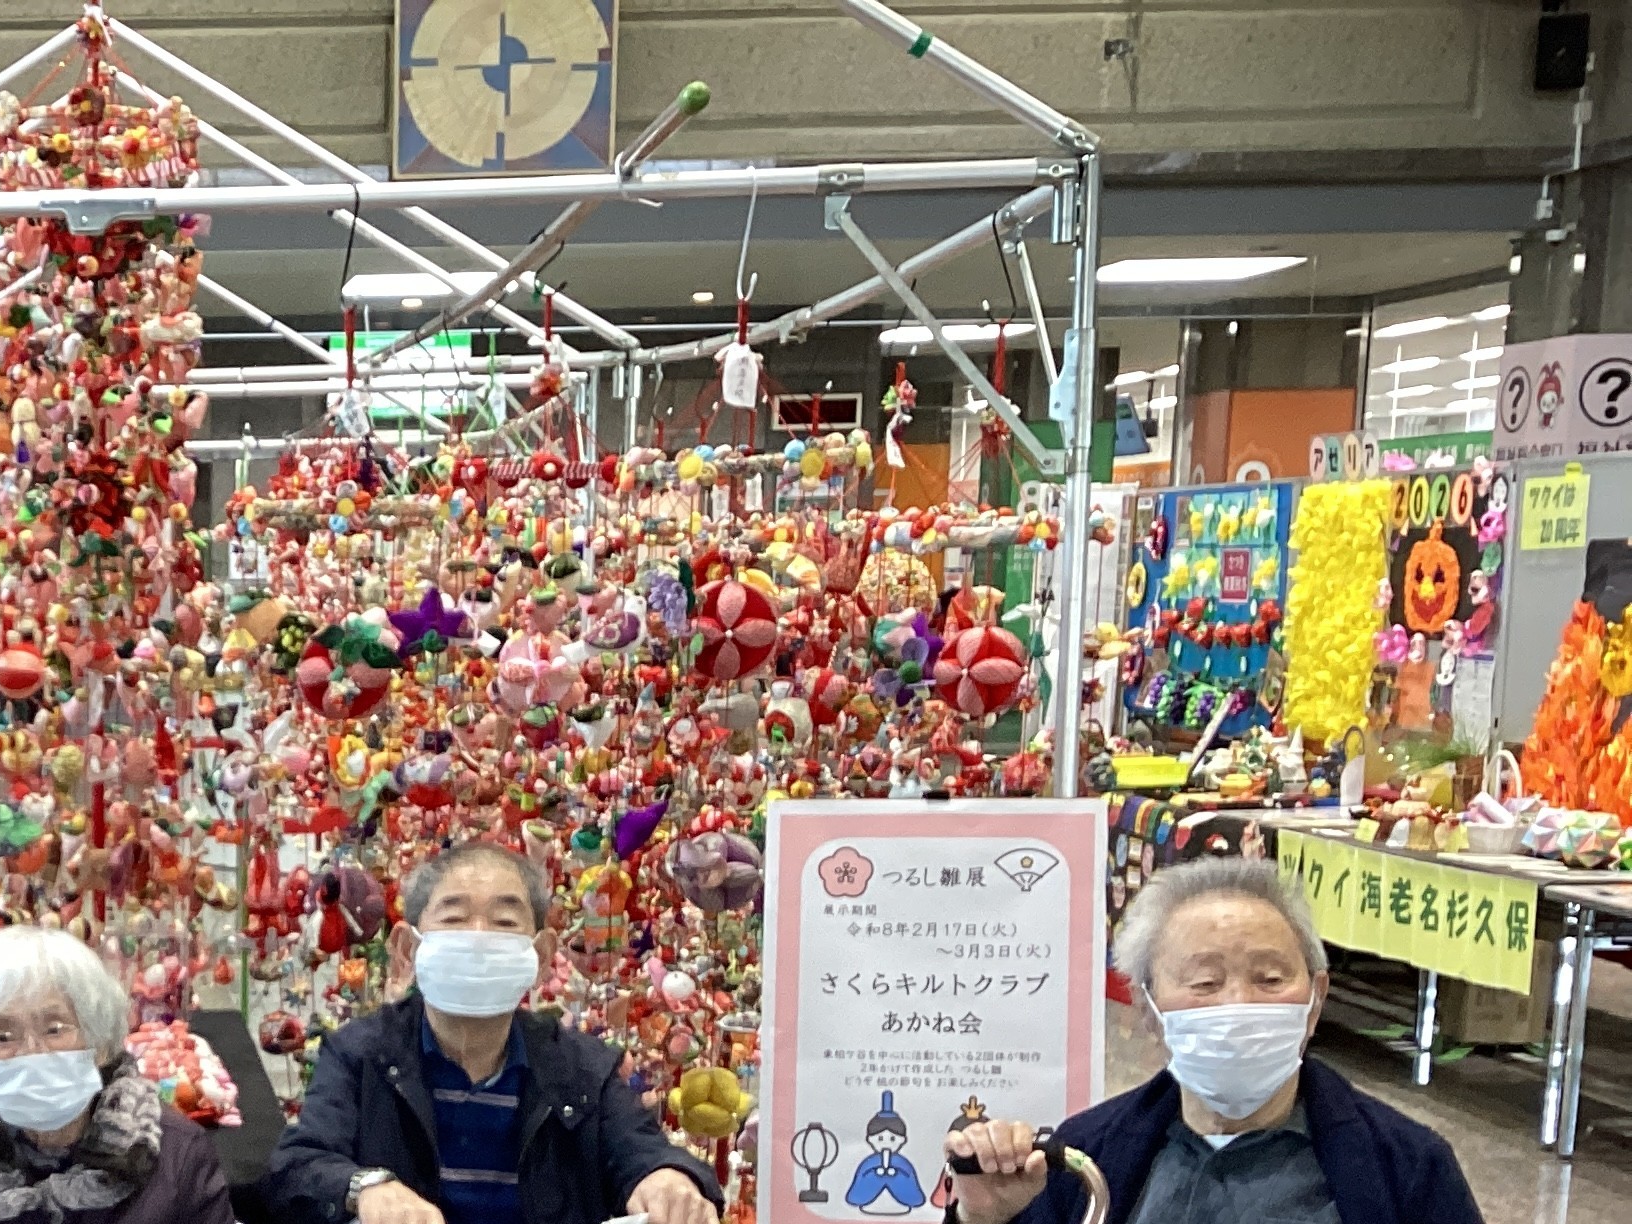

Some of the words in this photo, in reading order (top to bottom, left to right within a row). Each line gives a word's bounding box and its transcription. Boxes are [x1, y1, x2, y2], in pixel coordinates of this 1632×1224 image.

[1394, 481, 1474, 518] 2026
[882, 866, 987, 888] つるし雛展
[1282, 853, 1530, 952] ツクイ海老名杉久保
[819, 971, 1050, 996] さくらキルトクラブ
[881, 1011, 983, 1035] あかね会
